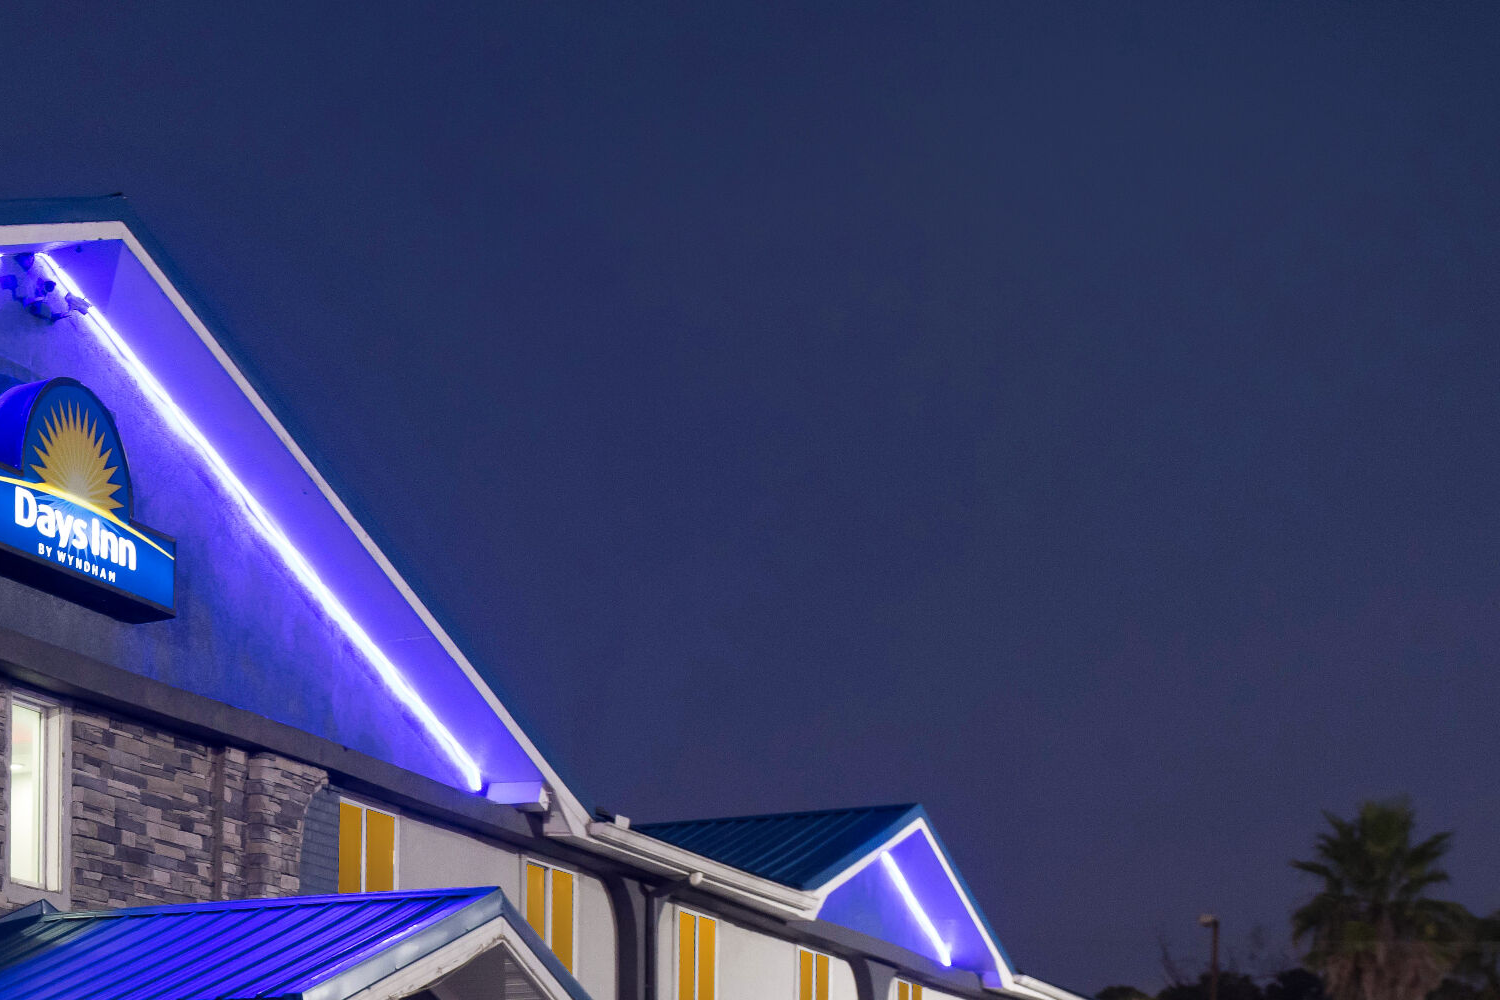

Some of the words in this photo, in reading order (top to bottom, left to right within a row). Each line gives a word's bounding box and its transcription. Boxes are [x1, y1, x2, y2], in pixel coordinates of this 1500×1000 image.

[15, 486, 88, 550] Days
[91, 518, 137, 571] Inn
[38, 543, 52, 558] BY
[57, 550, 116, 583] WYNDHAM
